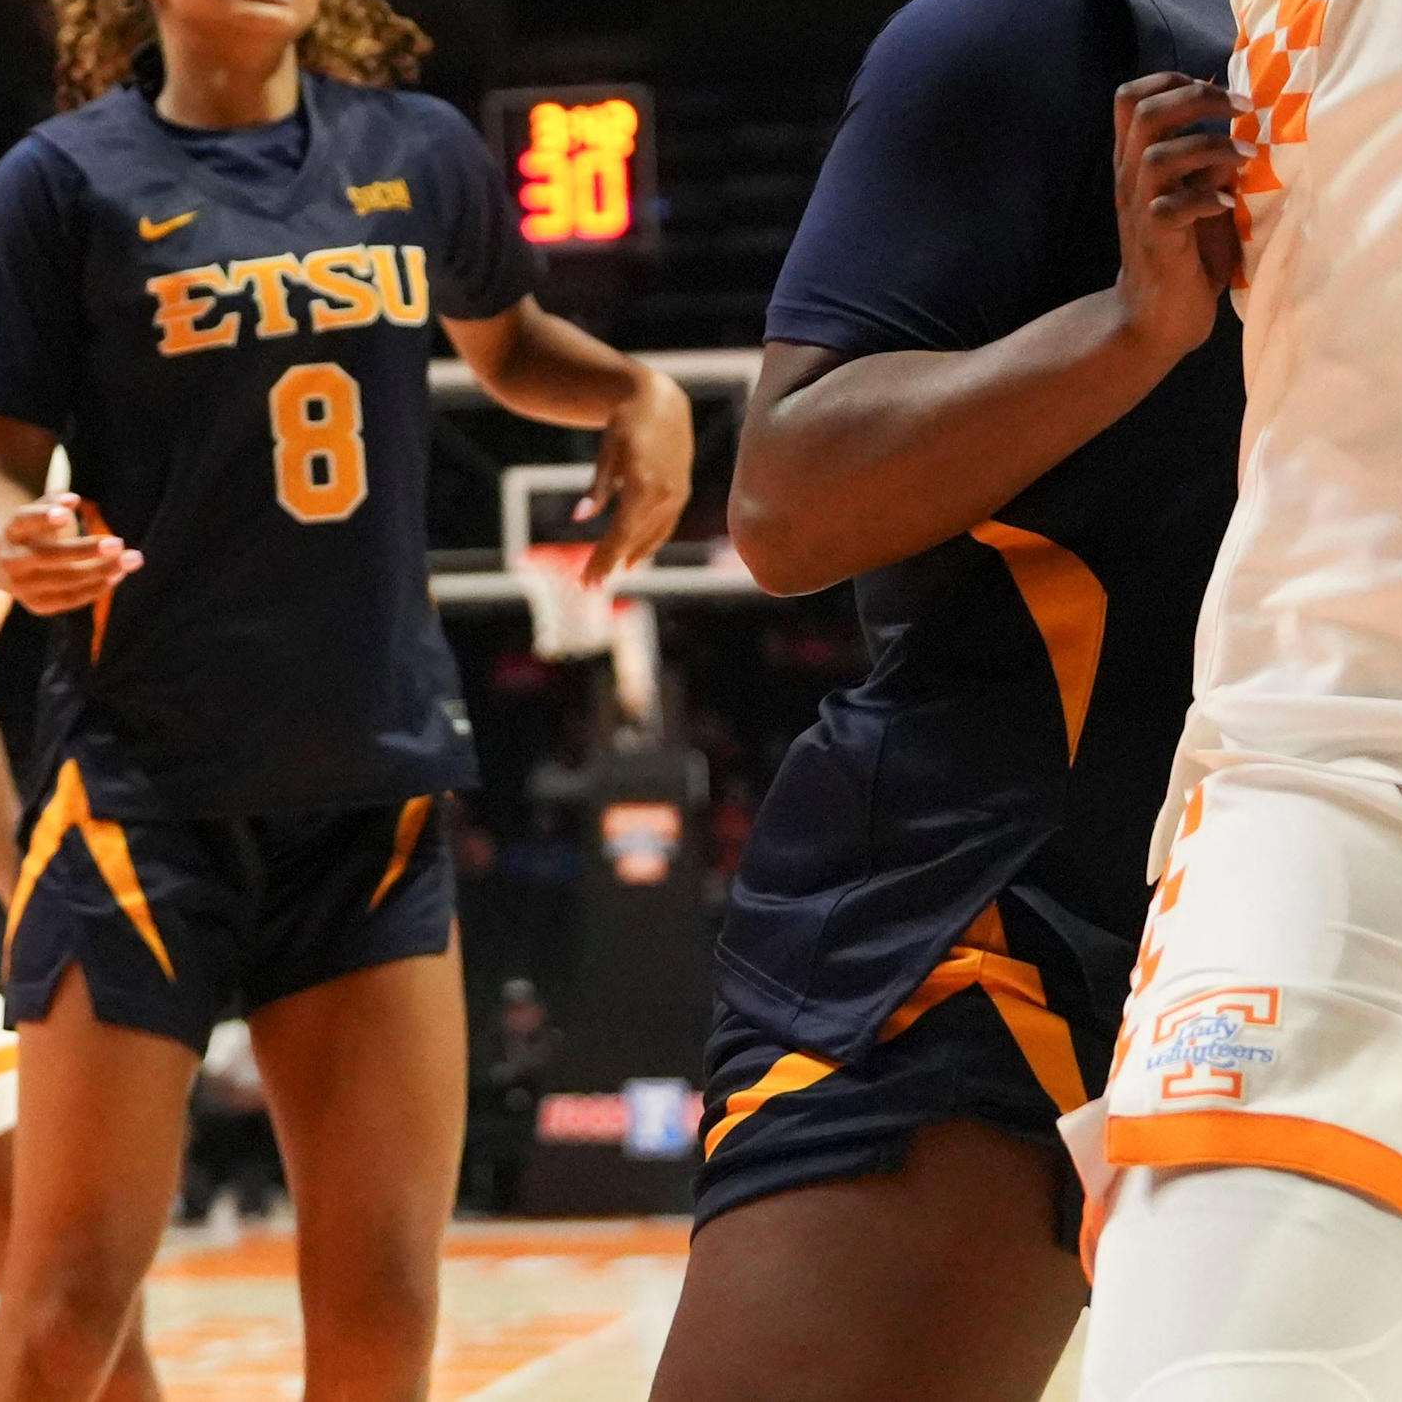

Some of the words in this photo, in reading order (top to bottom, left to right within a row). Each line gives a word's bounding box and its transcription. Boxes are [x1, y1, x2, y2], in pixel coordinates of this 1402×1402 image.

[517, 148, 632, 244] 30
[145, 243, 430, 356] ETSU
[269, 362, 368, 525] 8
